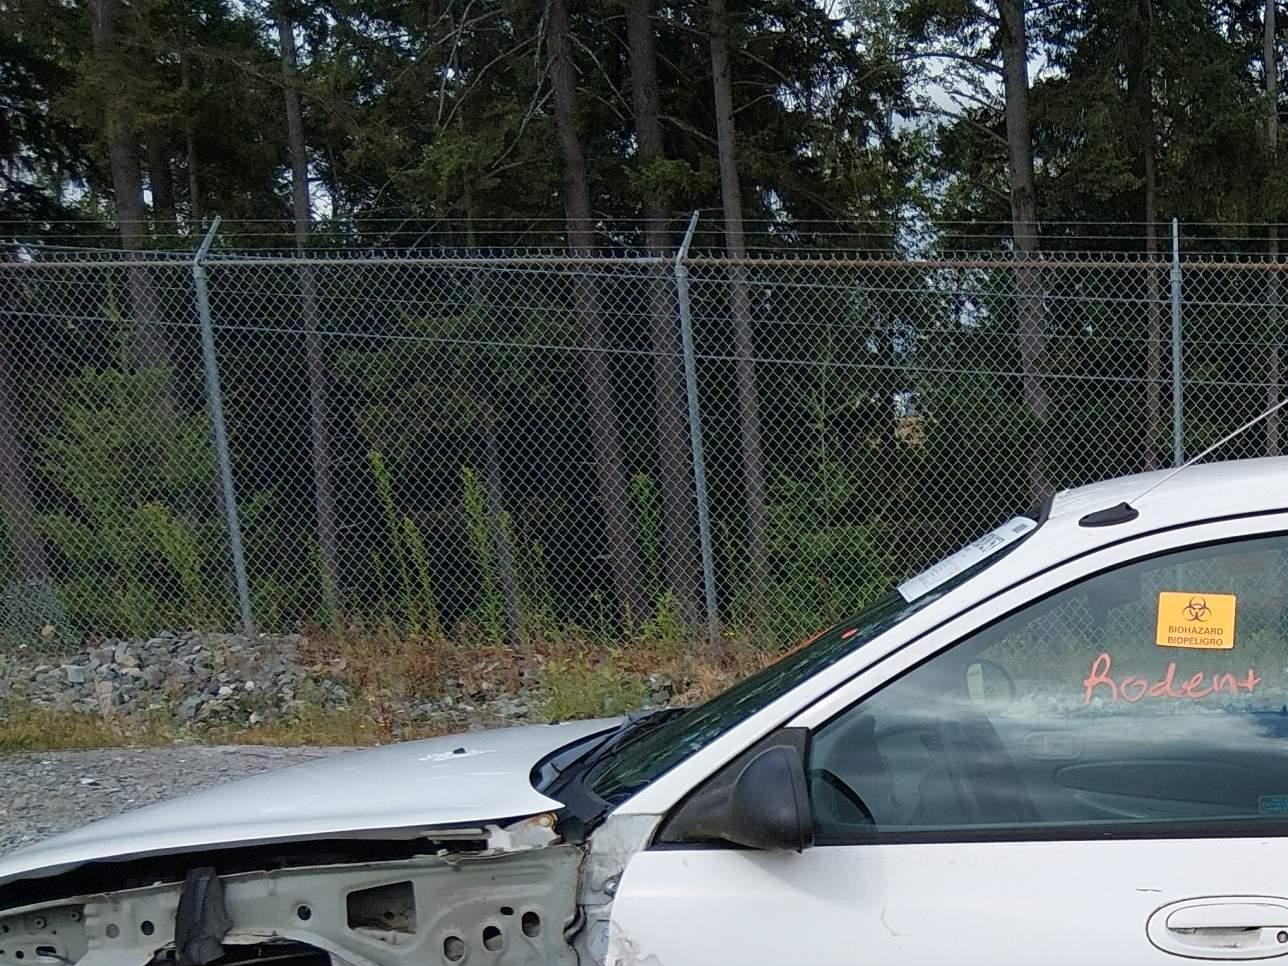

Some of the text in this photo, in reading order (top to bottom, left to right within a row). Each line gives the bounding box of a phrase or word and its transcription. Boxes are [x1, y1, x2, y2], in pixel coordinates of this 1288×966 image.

[1168, 625, 1224, 635] BIOHAZARD
[1167, 636, 1224, 646] BIOPELIGRO
[1083, 652, 1262, 705] Rodent
